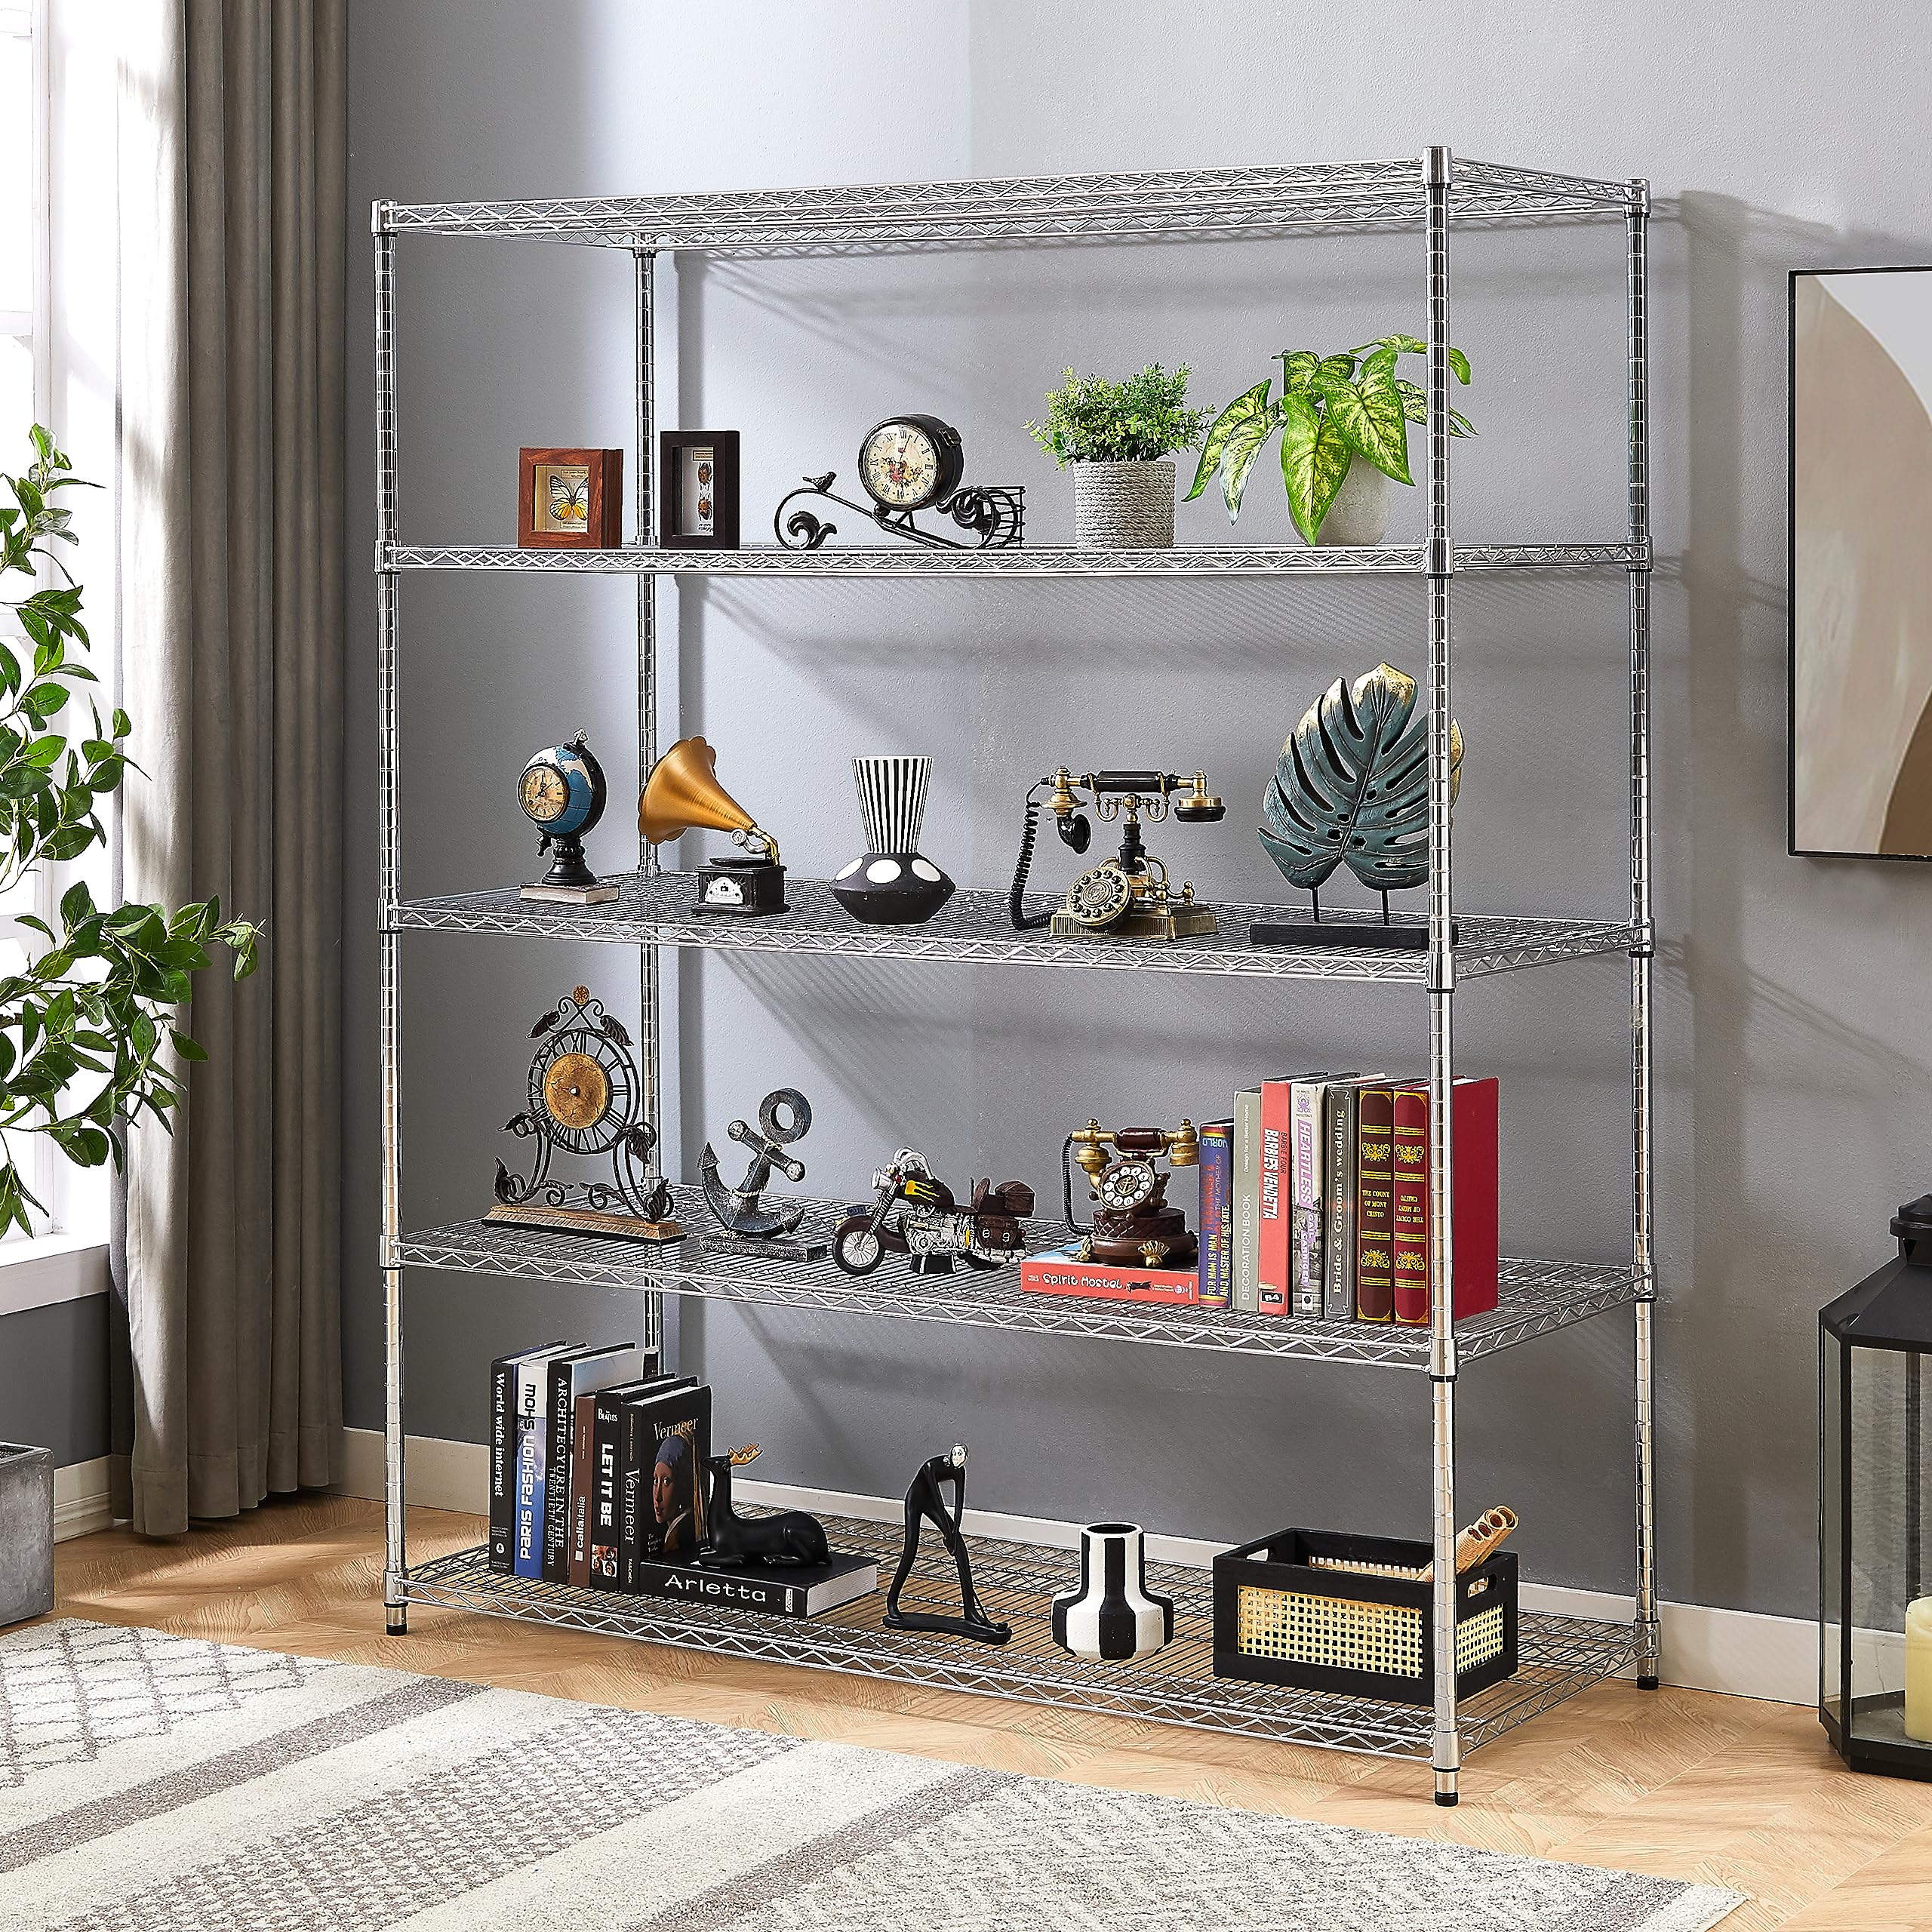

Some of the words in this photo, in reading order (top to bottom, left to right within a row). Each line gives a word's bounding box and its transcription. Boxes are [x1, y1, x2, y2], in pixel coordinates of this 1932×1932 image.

[1334, 1110, 1346, 1167] wedding
[1300, 1121, 1312, 1204] HEARTLESS
[1263, 1171, 1278, 1220] VENDETTA
[1334, 1171, 1343, 1233] Groom's
[1221, 1204, 1230, 1223] FATE.
[1242, 1194, 1251, 1226] BOOK
[1208, 1234, 1217, 1251] MAN
[1220, 1237, 1230, 1249] OF
[1221, 1223, 1230, 1237] HIS
[1334, 1237, 1343, 1251] &
[1208, 1252, 1217, 1261] IS
[1208, 1262, 1217, 1279] MAN
[1220, 1251, 1229, 1279] MASTER
[1042, 1273, 1078, 1286] Spirit
[1081, 1275, 1123, 1290] Hostel
[1334, 1254, 1342, 1294] Bride
[1208, 1281, 1217, 1296] FOR
[1220, 1281, 1229, 1297] AND
[495, 1373, 505, 1414] World
[524, 1383, 536, 1430] SHOW
[495, 1415, 506, 1446] wide
[556, 1377, 568, 1494] ARCHITECYURE
[653, 1417, 700, 1441] Vermeer
[494, 1447, 506, 1497] internet
[601, 1443, 614, 1477] LET
[601, 1480, 613, 1499] IT
[555, 1497, 565, 1514] IN
[600, 1501, 612, 1527] BE
[624, 1468, 641, 1545] Vermeer
[519, 1509, 533, 1560] PARIS
[555, 1516, 565, 1548] THE
[664, 1574, 767, 1602] Arletta
